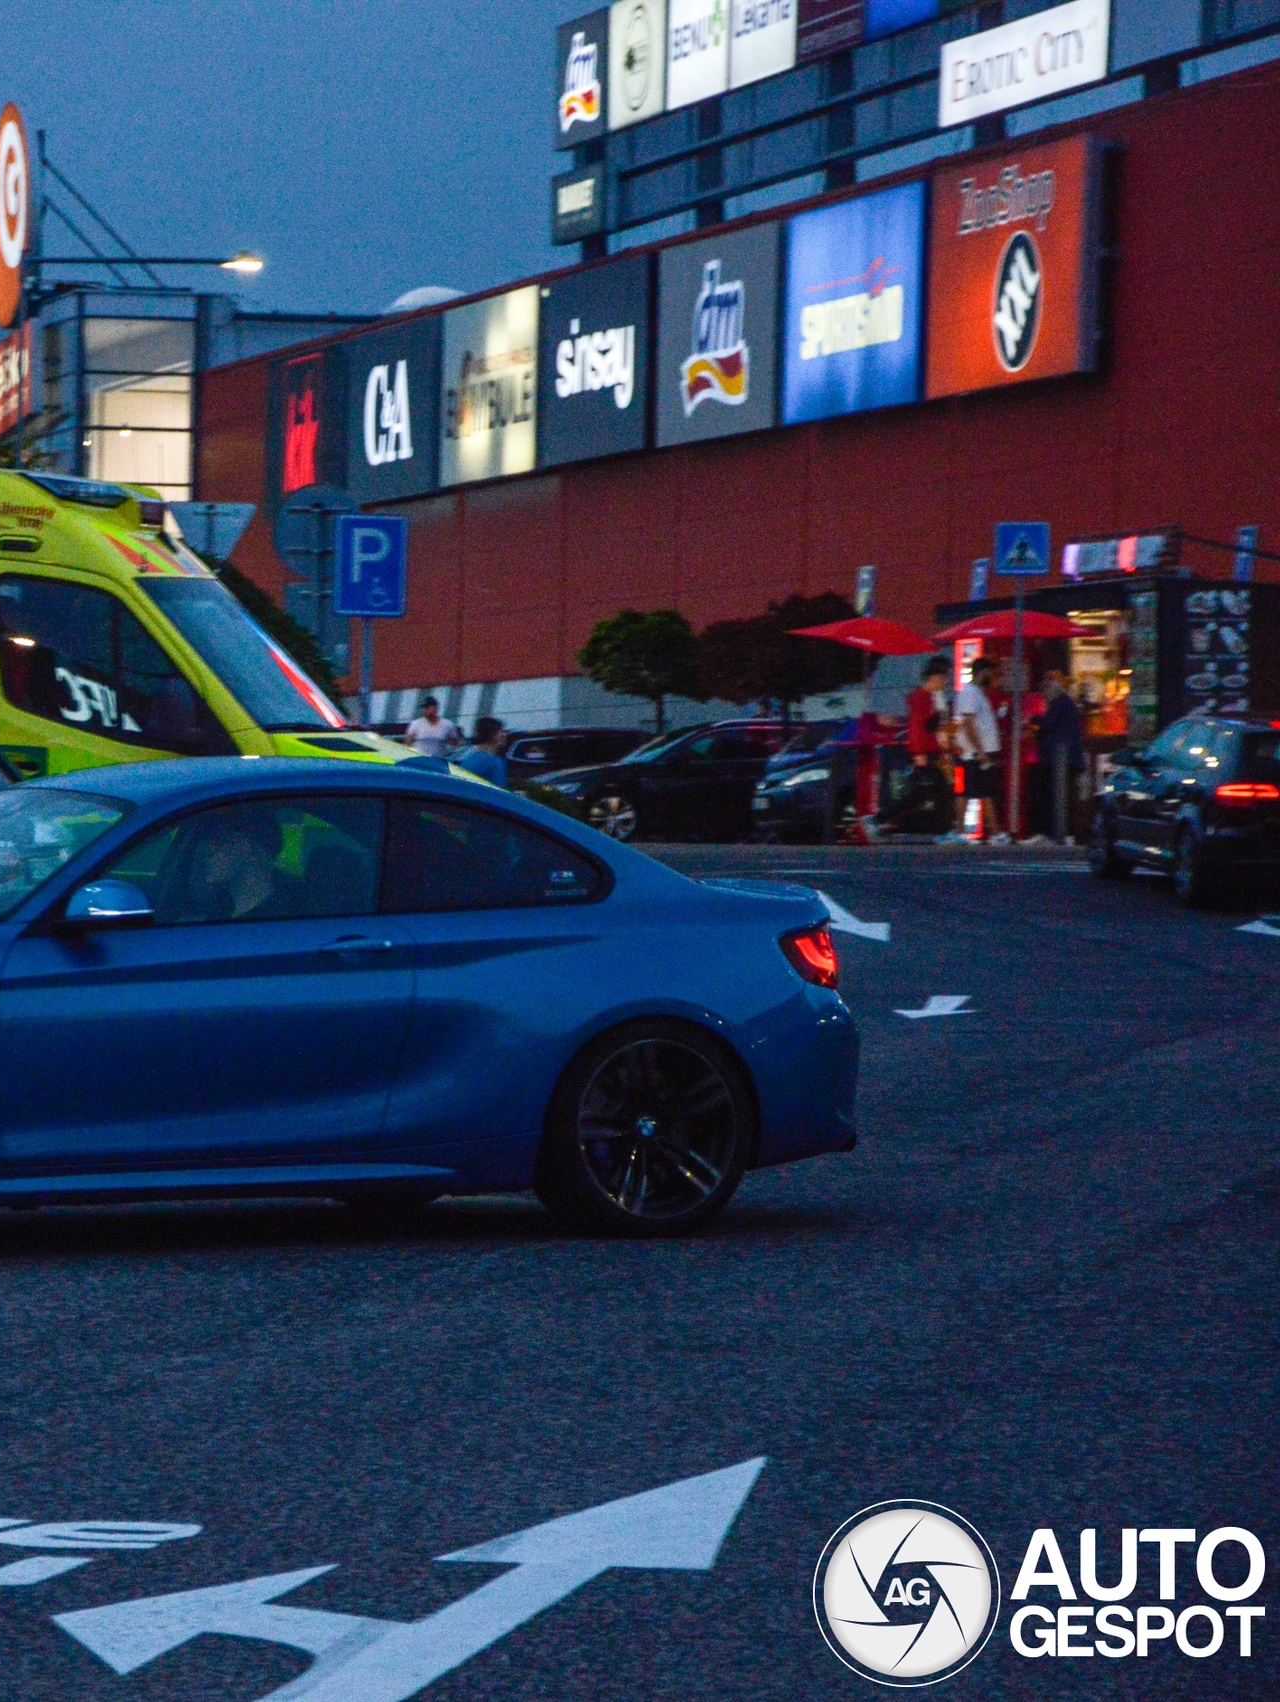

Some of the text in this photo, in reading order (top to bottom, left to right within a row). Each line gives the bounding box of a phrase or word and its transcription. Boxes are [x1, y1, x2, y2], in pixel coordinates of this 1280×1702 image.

[555, 317, 636, 409] sinsay
[363, 358, 414, 467] C&A
[351, 527, 391, 583] P
